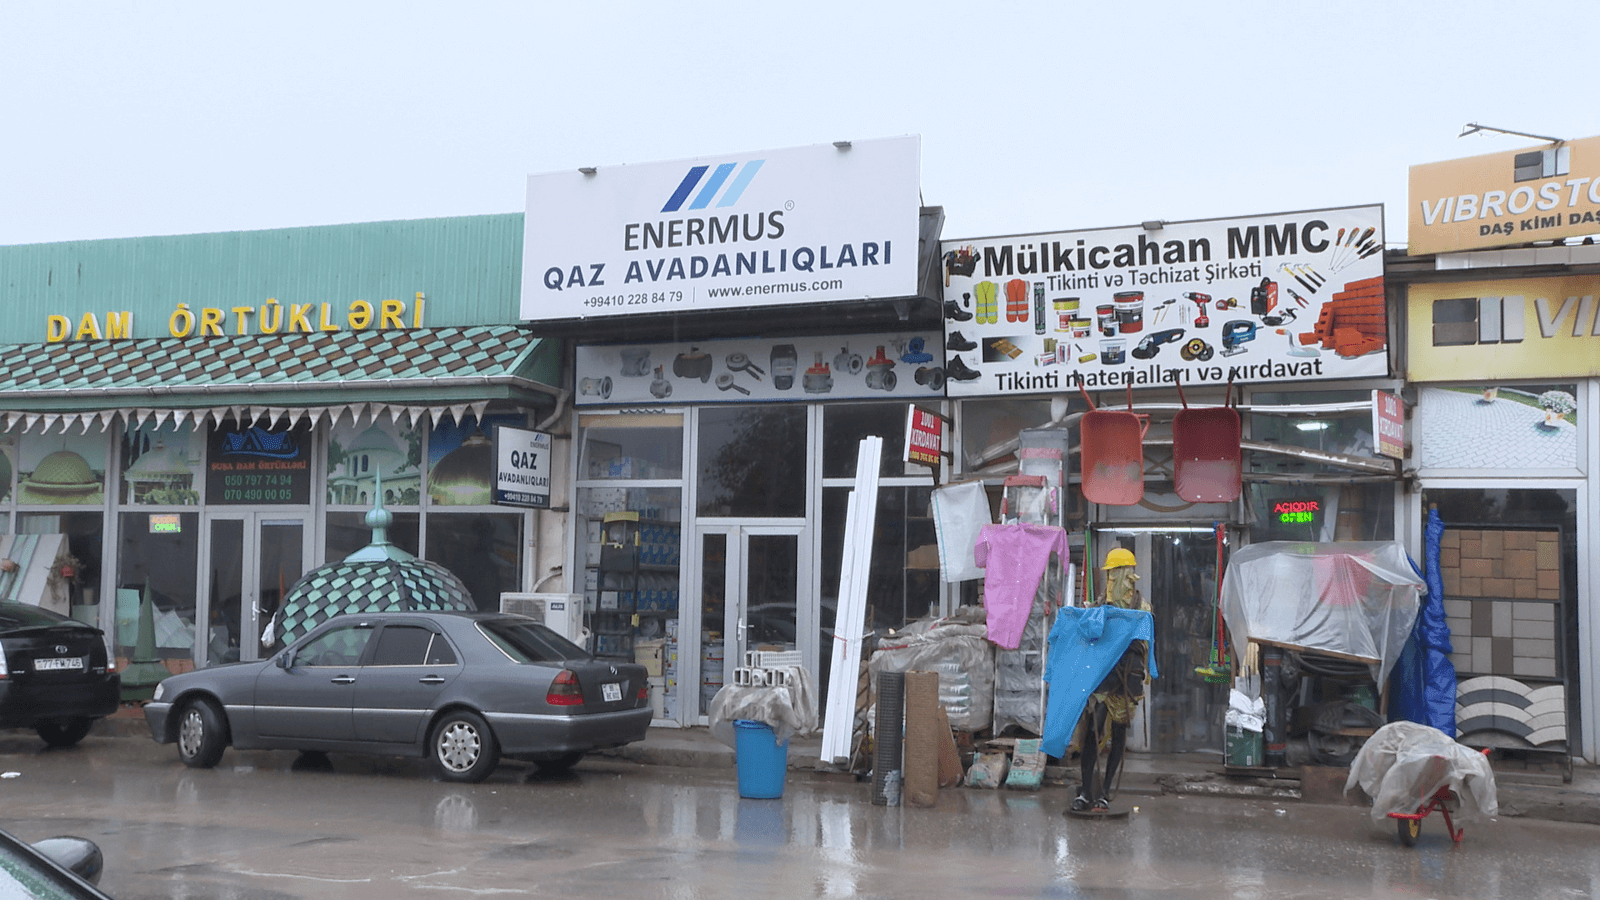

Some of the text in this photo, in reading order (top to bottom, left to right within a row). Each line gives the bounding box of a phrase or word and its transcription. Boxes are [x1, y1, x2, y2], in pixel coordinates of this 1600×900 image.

[625, 210, 785, 252] ENERMUS
[1480, 220, 1514, 236] DAŞ
[1520, 212, 1562, 232] KİMİ
[983, 219, 1330, 277] Mülkicahan MMC
[543, 240, 892, 292] QAZ AVADANLIQLARI
[1047, 260, 1262, 291] Tikinti və Təchizat Şirkəti
[583, 290, 683, 308] +99410 228 84 79
[707, 277, 843, 299] www.enermus.com
[47, 292, 426, 342] DAM ÖRTÜKLƏRİ
[995, 371, 1058, 392] Tikinti
[1066, 364, 1189, 388] materialları
[1197, 366, 1222, 381] və
[510, 449, 538, 470] QAZ
[245, 475, 262, 485] 797
[266, 475, 277, 485] 74
[498, 472, 549, 487] AVADANLIQLARI
[224, 489, 292, 500] 070 490 00 05
[1279, 511, 1313, 523] OPEN
